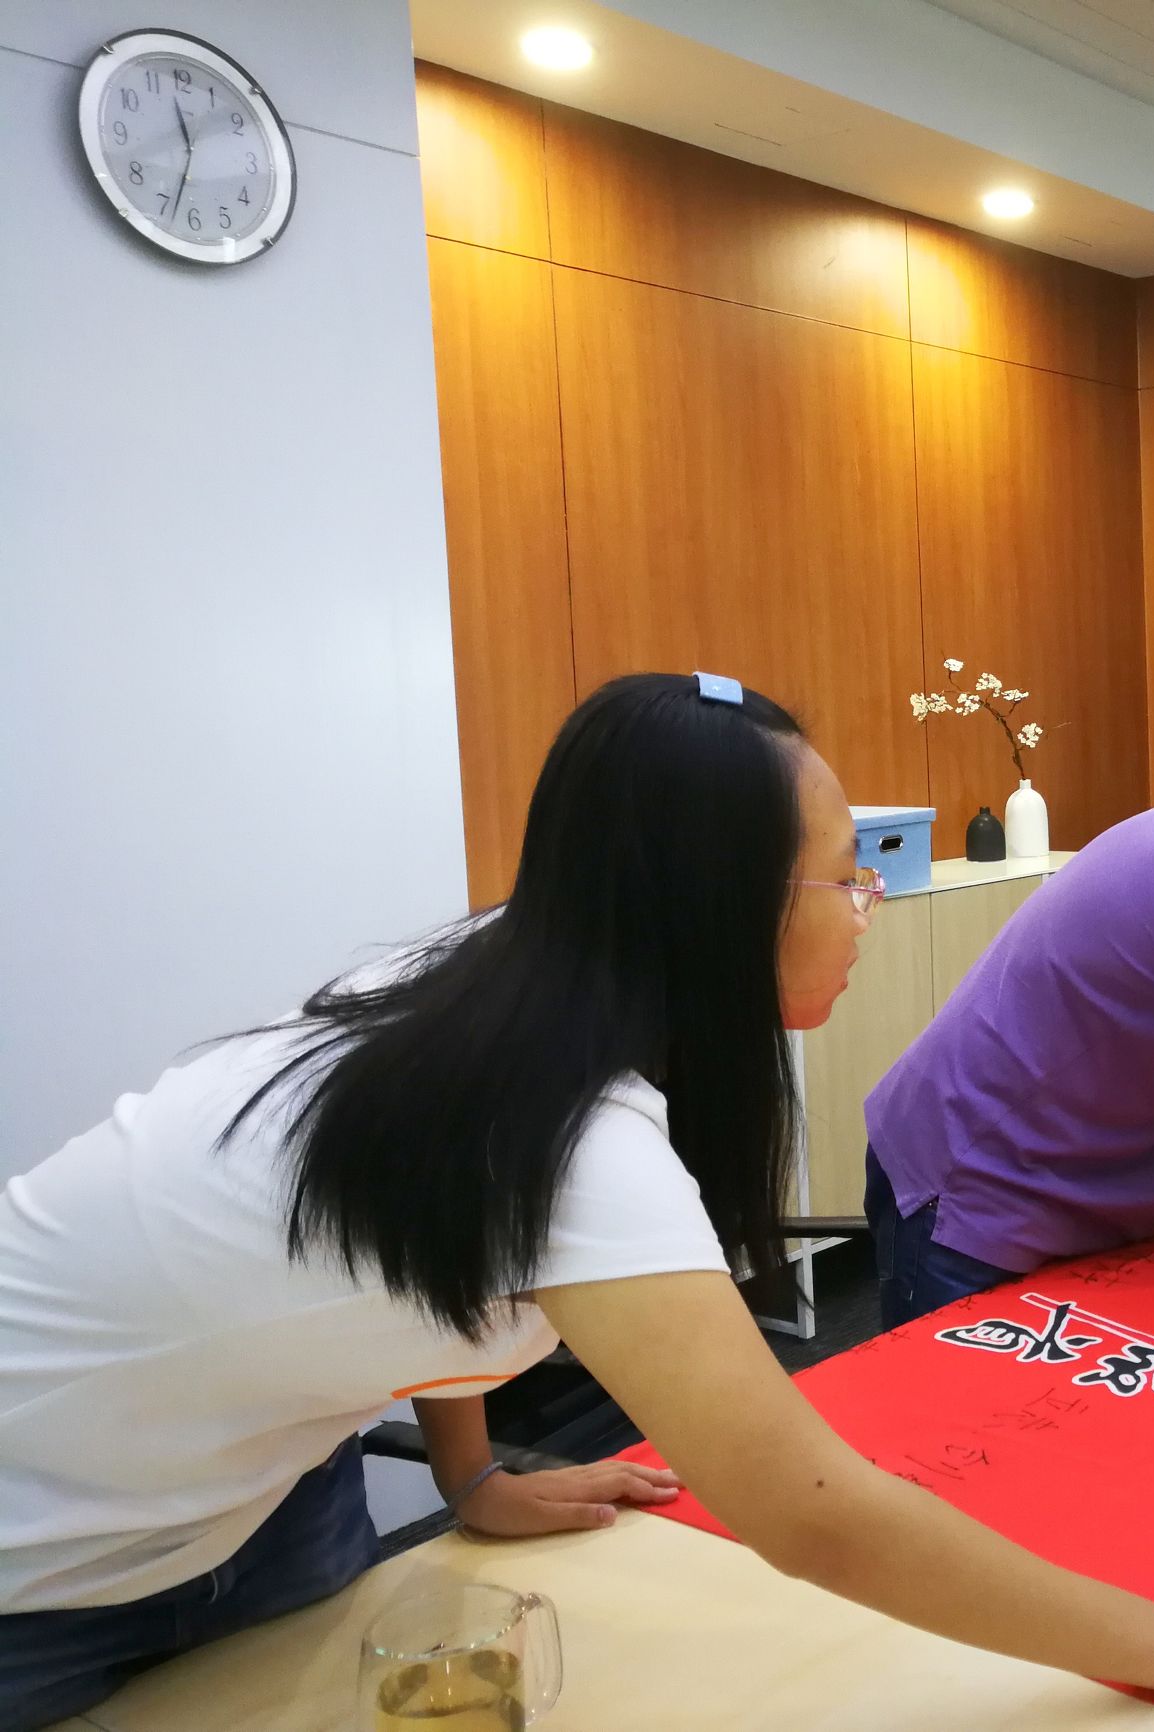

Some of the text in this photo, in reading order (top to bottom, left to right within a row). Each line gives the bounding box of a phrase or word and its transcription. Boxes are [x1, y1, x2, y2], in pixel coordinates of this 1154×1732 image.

[145, 70, 160, 94] 11
[173, 68, 192, 94] 12
[120, 88, 139, 113] 10
[208, 86, 215, 108] 1
[112, 121, 128, 146] 9
[231, 112, 244, 136] 2
[128, 160, 144, 186] 8
[245, 151, 258, 175] 3
[155, 193, 171, 216] 7
[237, 185, 251, 207] 4
[187, 207, 202, 232] 6
[219, 206, 232, 230] 5
